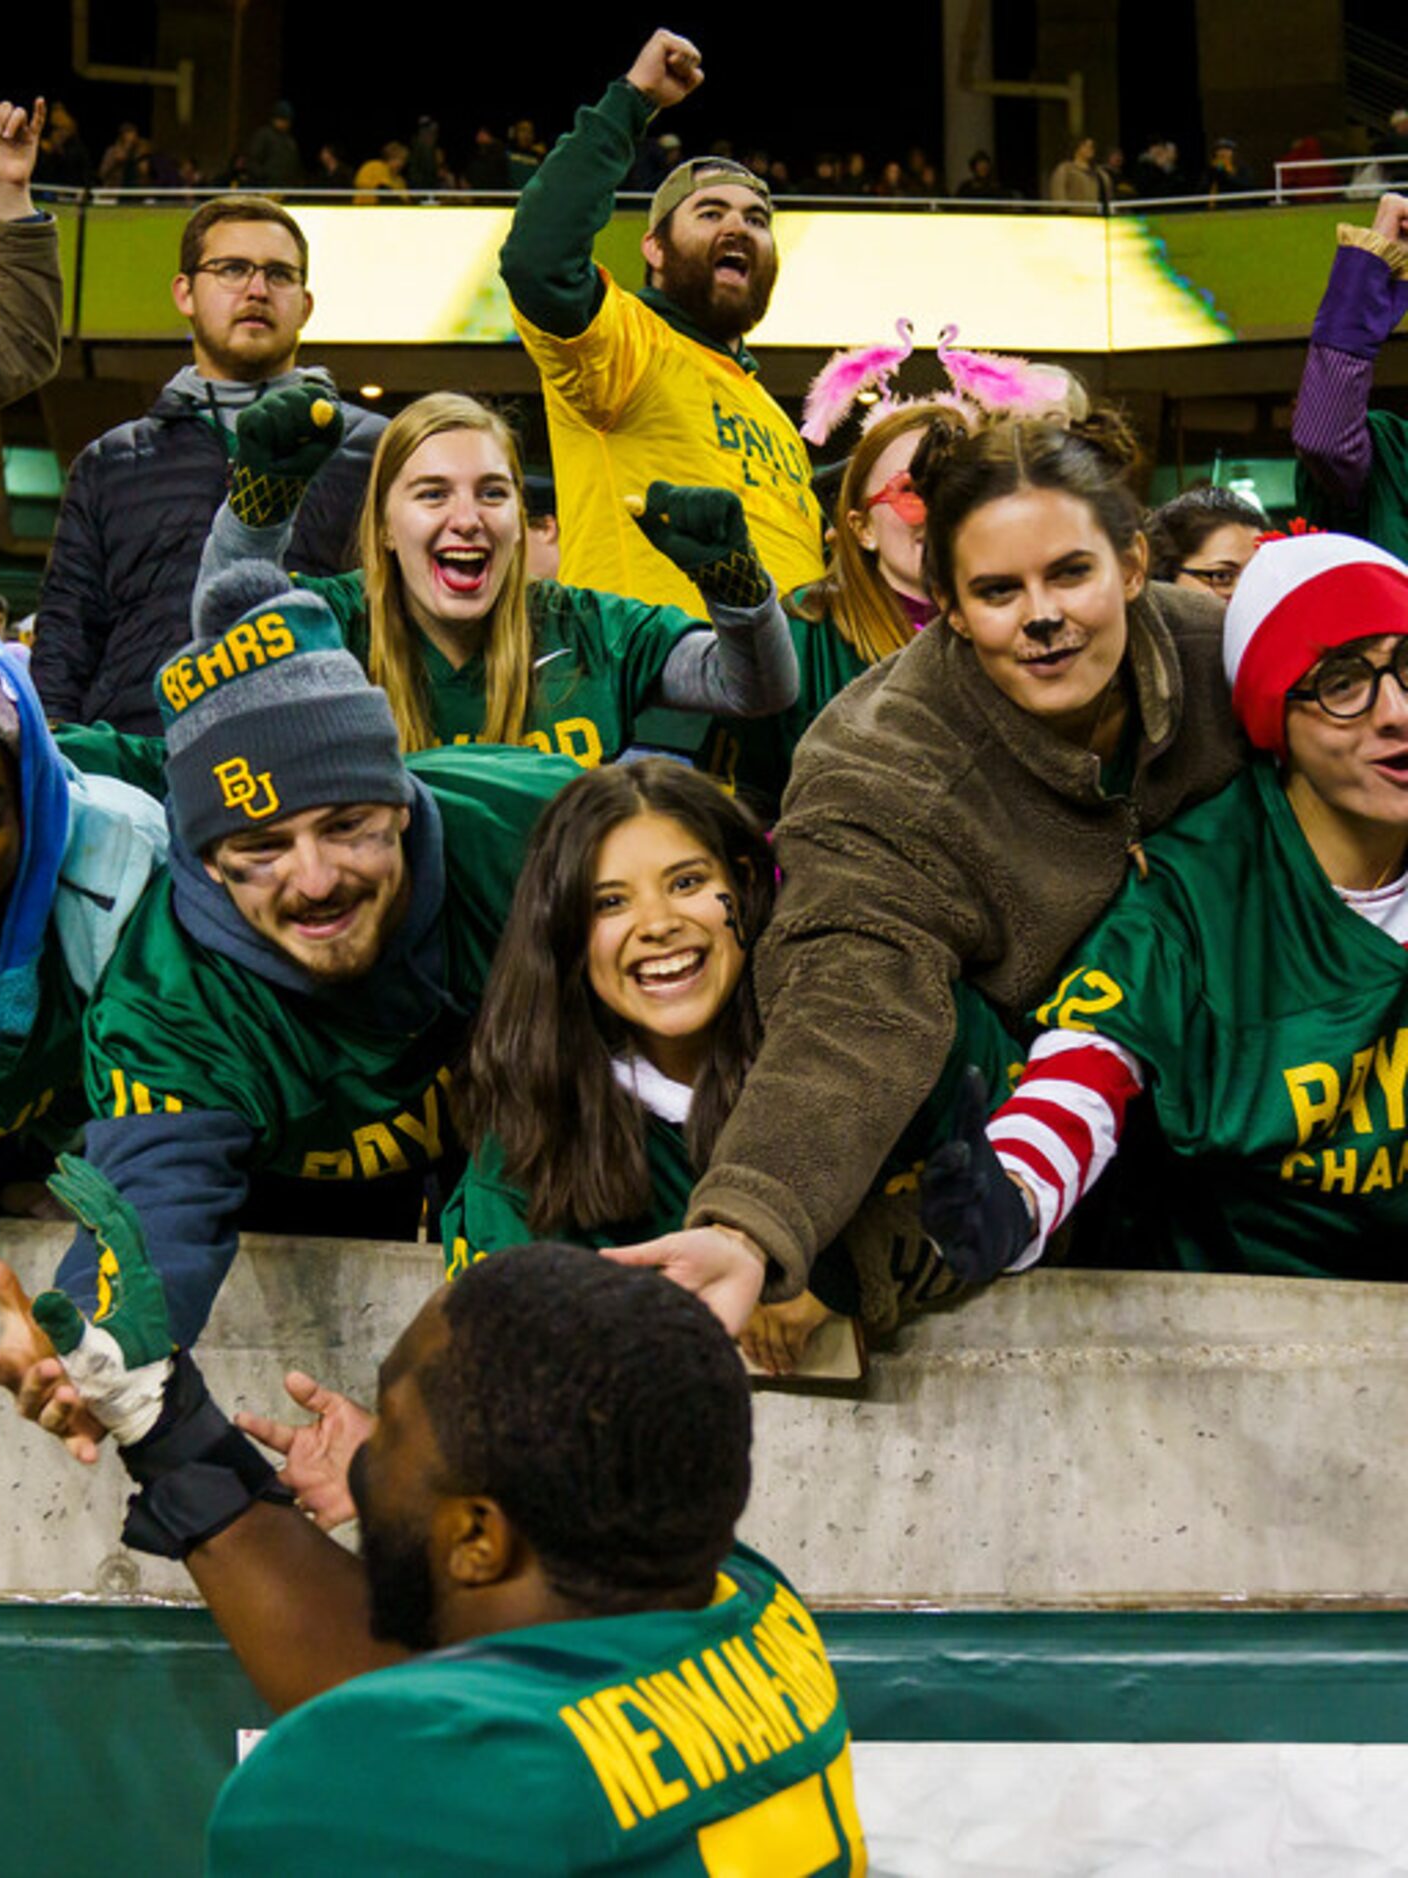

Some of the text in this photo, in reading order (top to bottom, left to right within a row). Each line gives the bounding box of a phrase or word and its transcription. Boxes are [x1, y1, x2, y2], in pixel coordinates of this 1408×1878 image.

[161, 612, 295, 713] BEARS
[212, 756, 279, 819] BU
[1280, 1141, 1408, 1194] CHA
